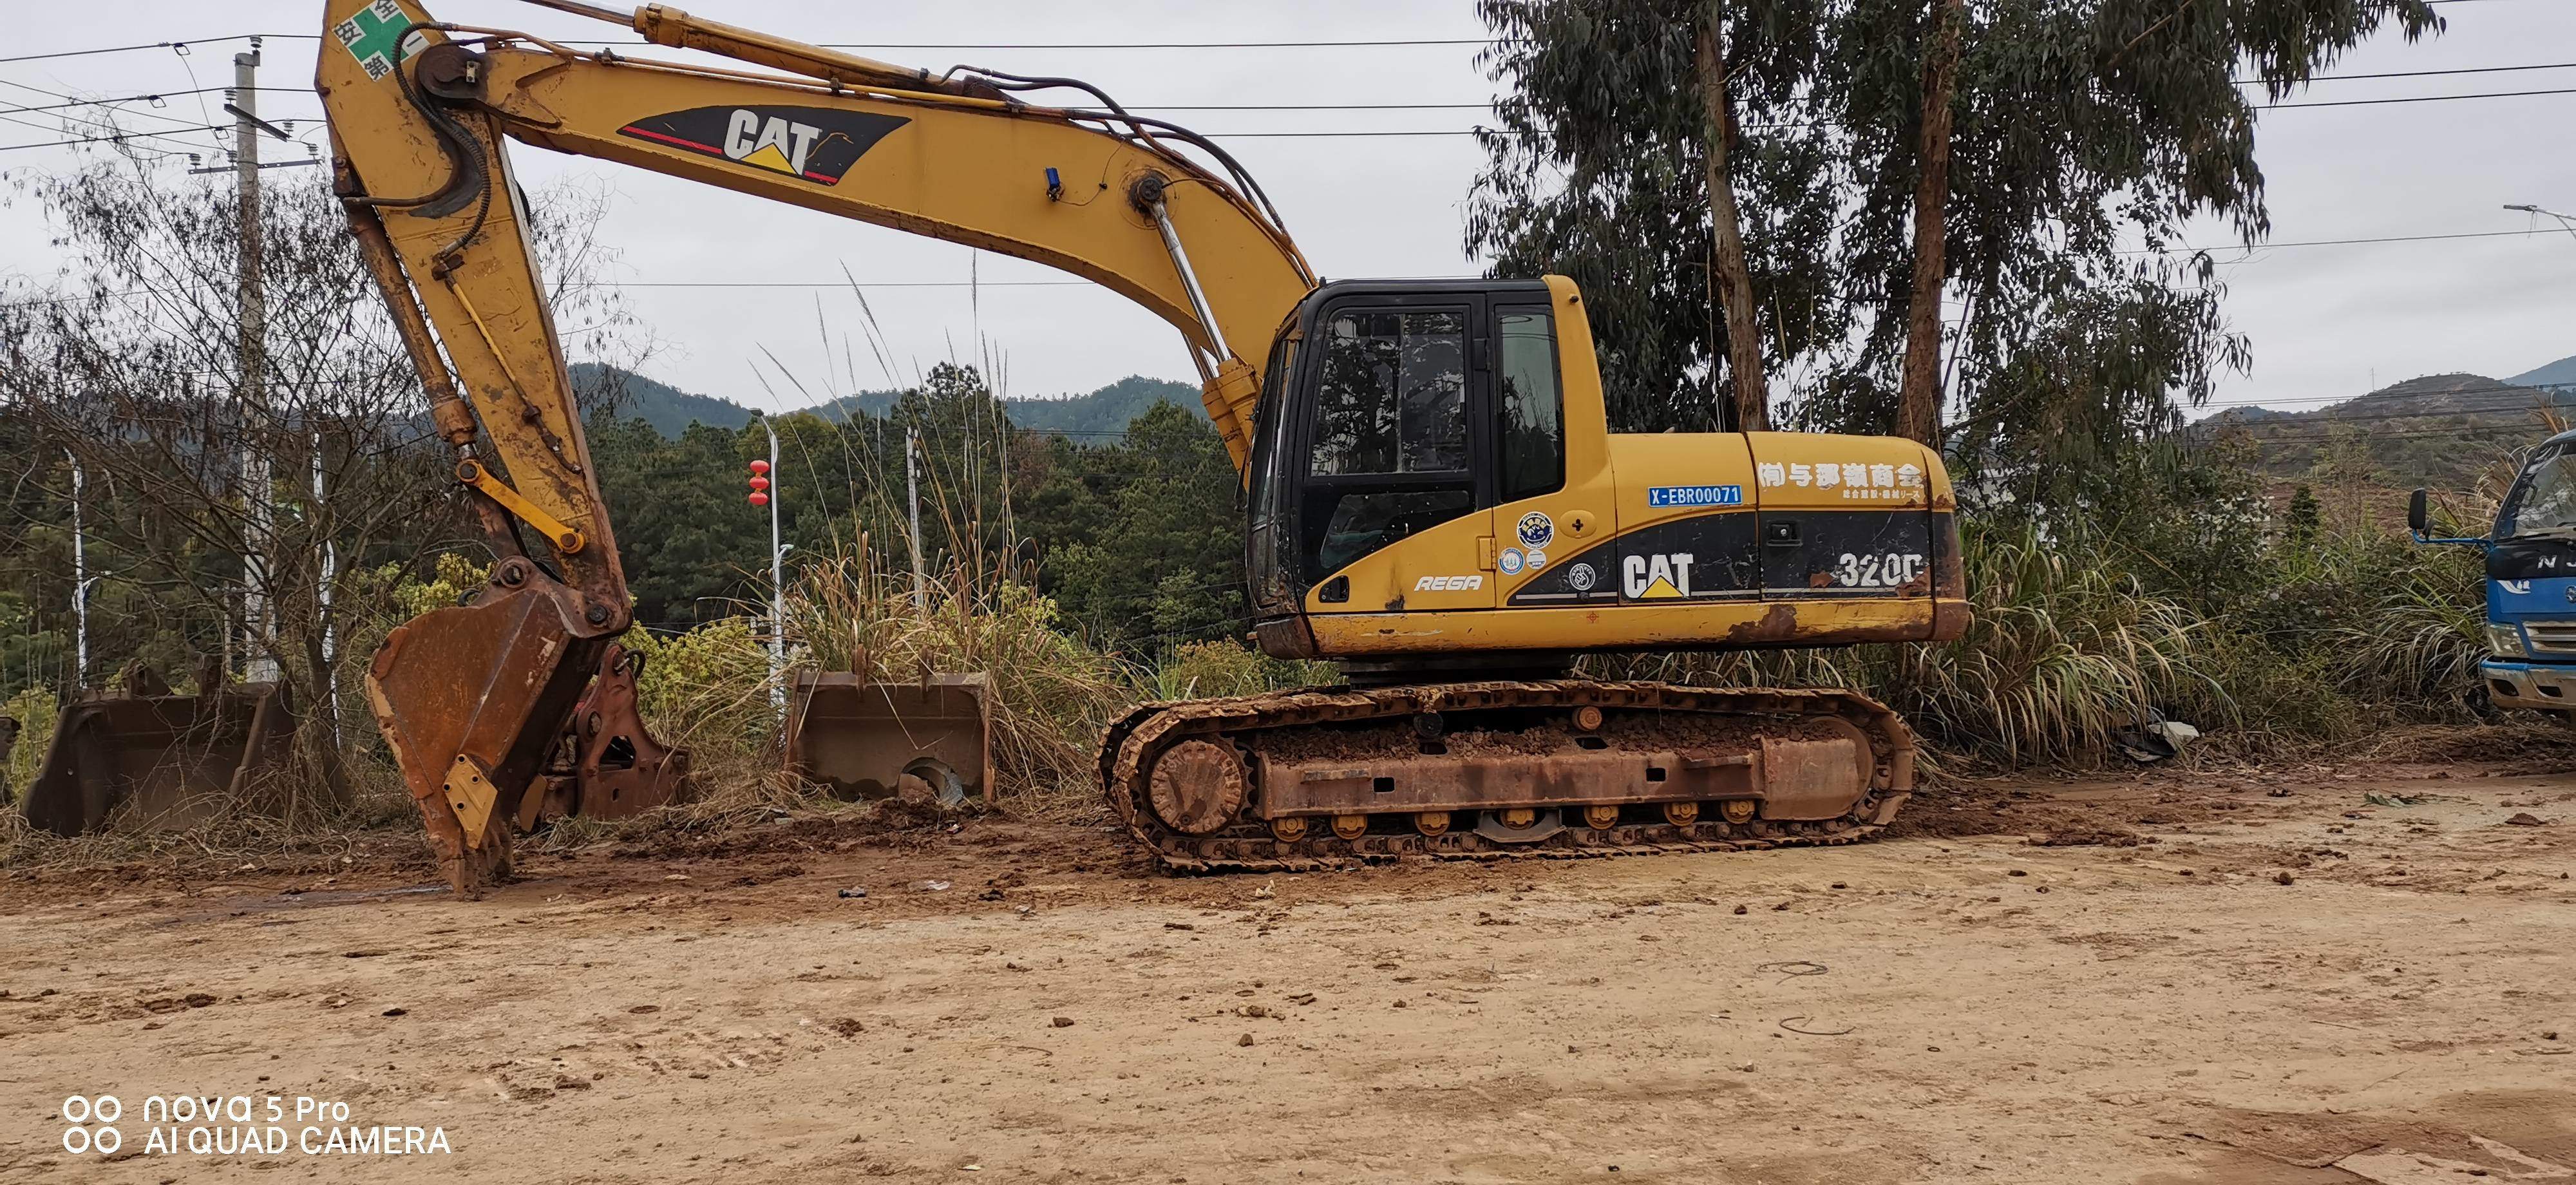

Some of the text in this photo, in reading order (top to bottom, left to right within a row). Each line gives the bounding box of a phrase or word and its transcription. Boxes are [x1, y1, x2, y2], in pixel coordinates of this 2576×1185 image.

[724, 109, 820, 175] CAT
[1651, 487, 1739, 504] X-EBR00071
[1414, 575, 1483, 591] REGA
[1623, 553, 1694, 598] CAT
